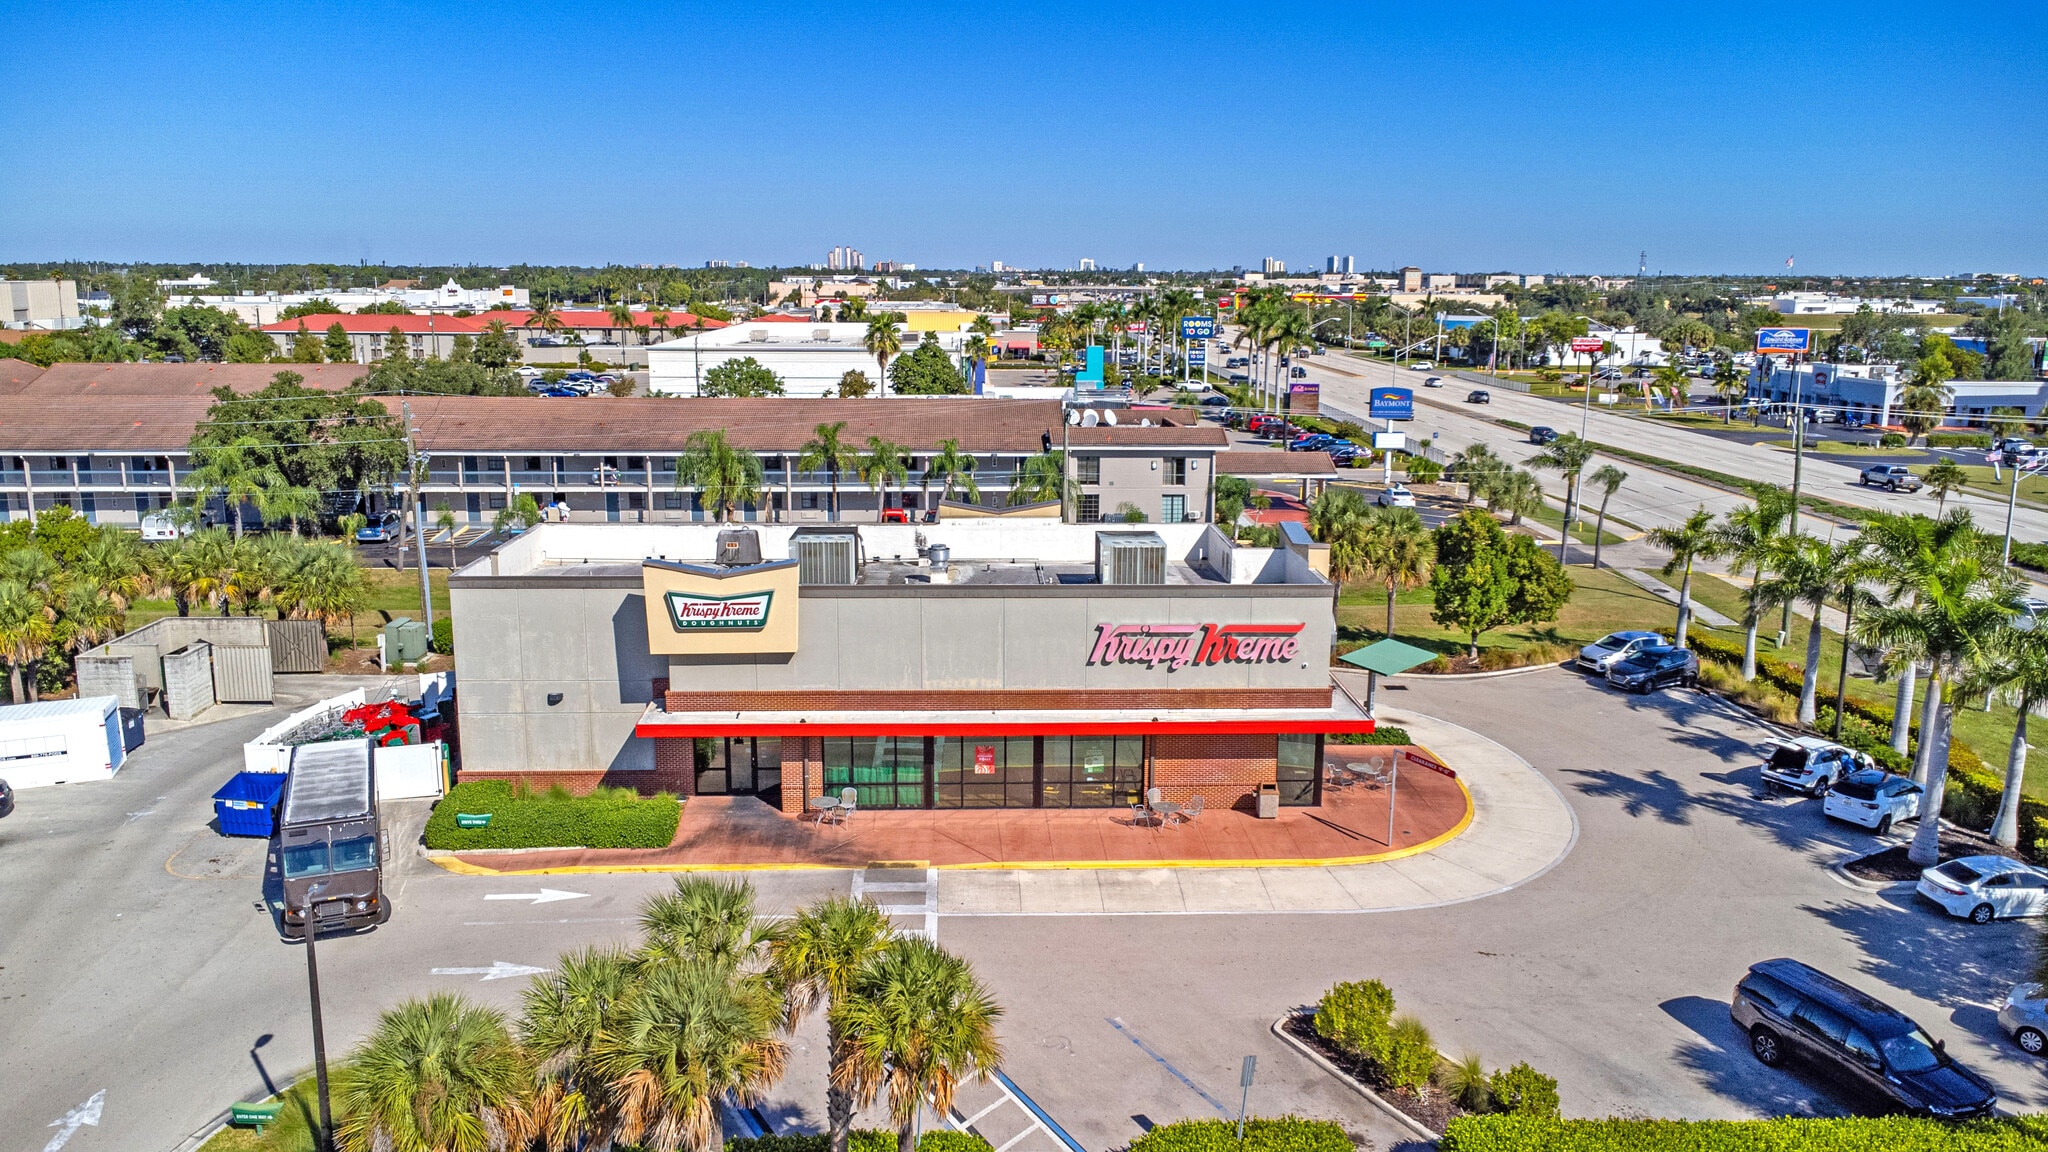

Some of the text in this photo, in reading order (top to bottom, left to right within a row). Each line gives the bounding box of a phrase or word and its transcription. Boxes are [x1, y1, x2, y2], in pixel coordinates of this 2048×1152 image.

[1183, 320, 1212, 328] ROOMS
[680, 602, 762, 619] Krispy Kreme
[1087, 622, 1306, 672] Krispy Kreme
[1410, 755, 1437, 769] CLEARANCE
